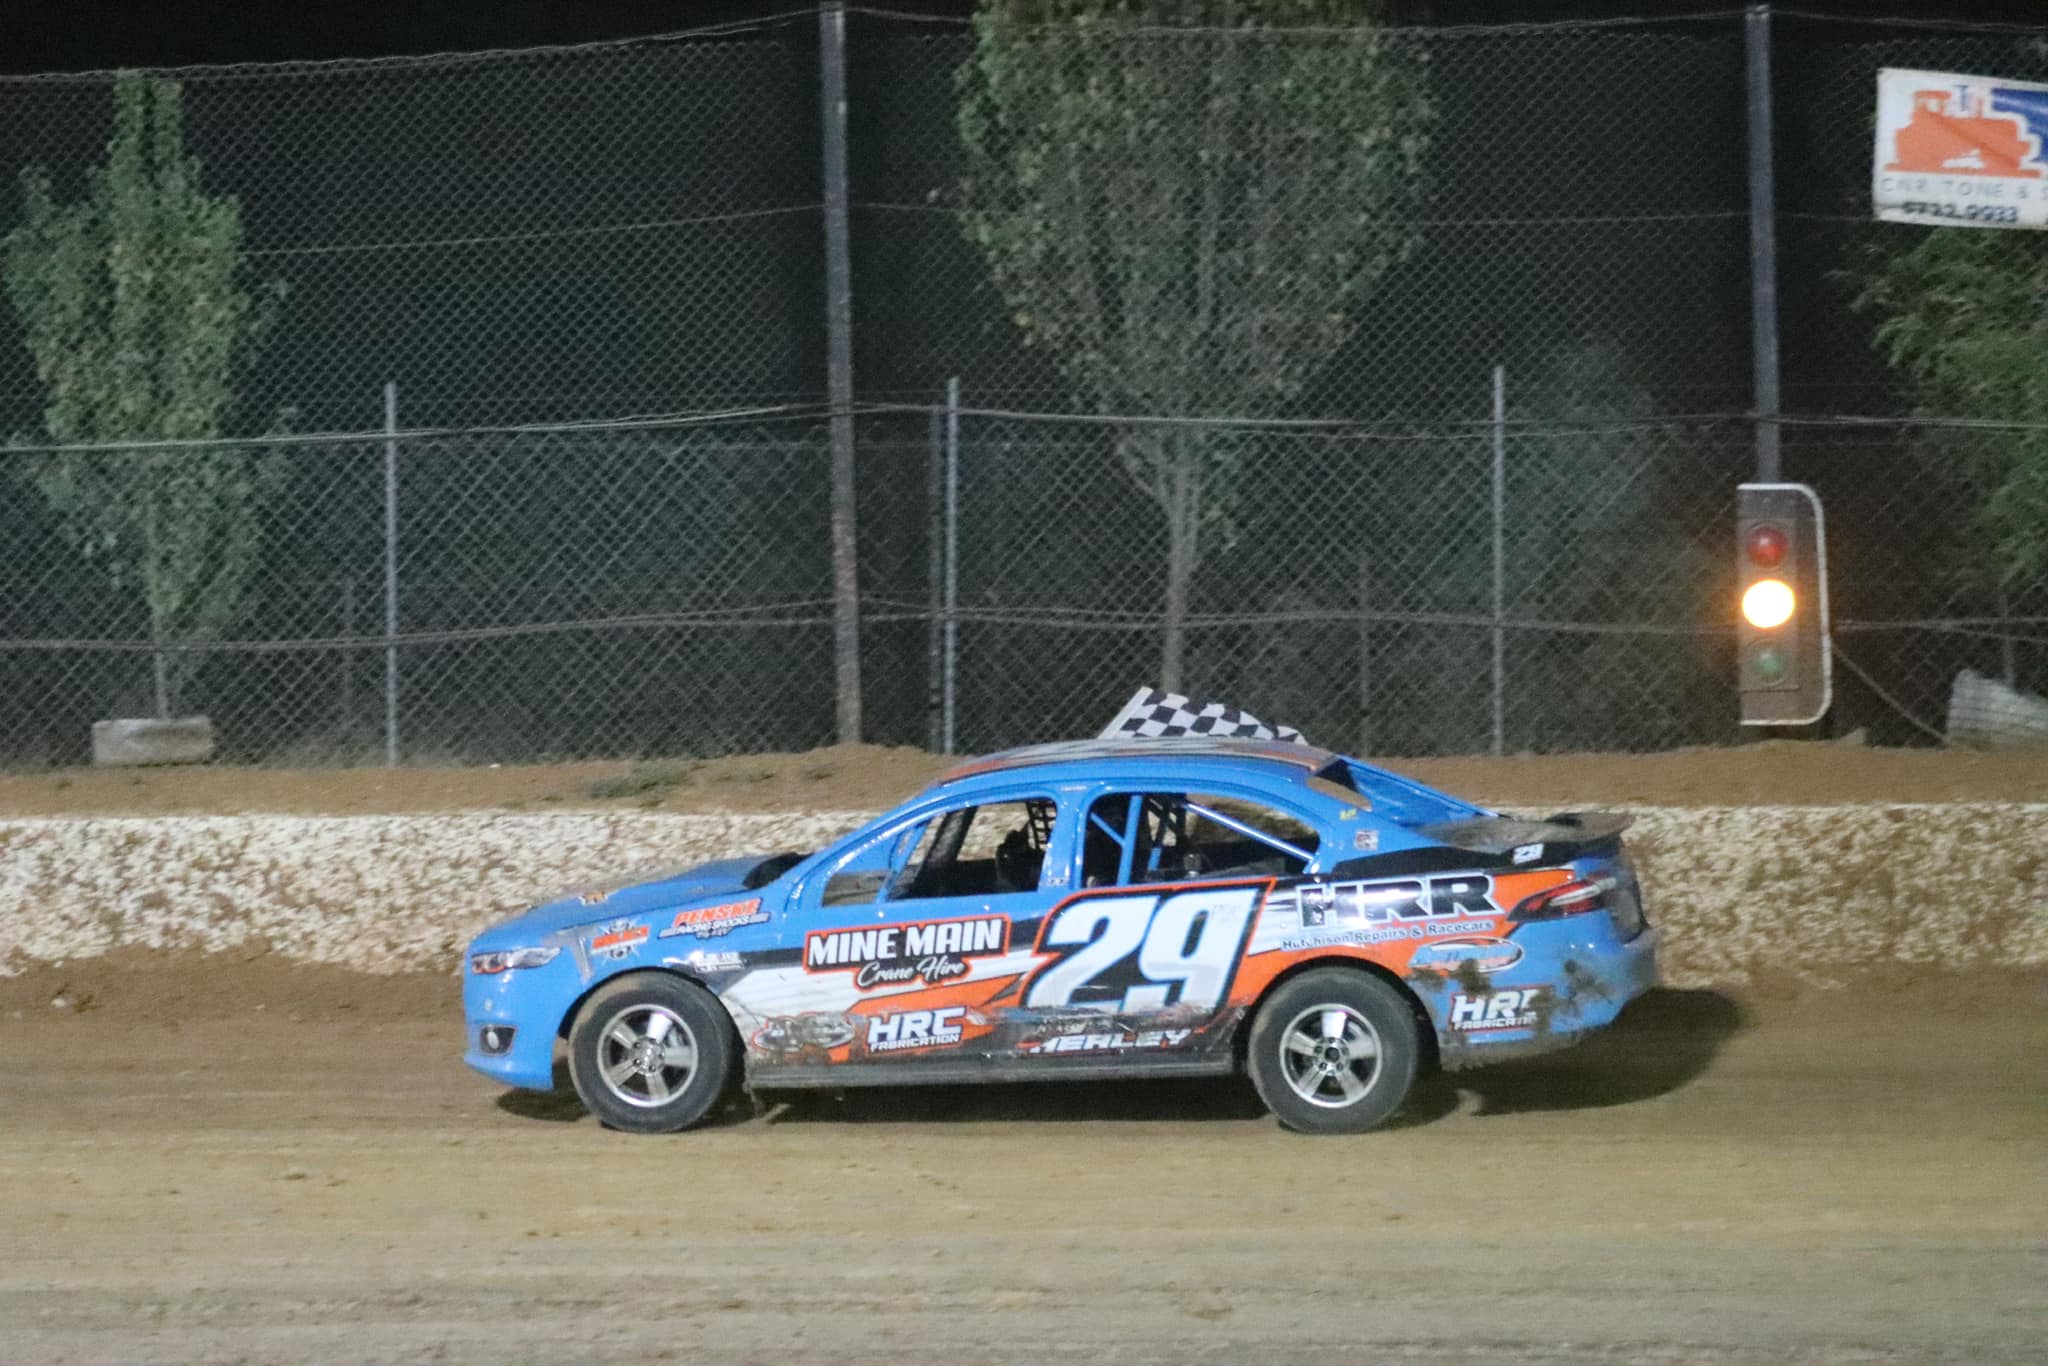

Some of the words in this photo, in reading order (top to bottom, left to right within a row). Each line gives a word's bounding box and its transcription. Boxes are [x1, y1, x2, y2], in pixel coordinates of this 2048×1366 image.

[673, 897, 762, 928] PENSKE
[1296, 872, 1505, 929] HRR
[808, 928, 900, 967] MINE
[905, 919, 1002, 957] MAIN
[1355, 928, 1406, 944] Repairs
[1411, 926, 1422, 937] &
[1428, 921, 1493, 935] Racecars
[1027, 887, 1261, 1014] 29
[857, 961, 914, 987] Crane
[916, 955, 966, 982] Hire
[868, 1006, 966, 1043] HRC
[870, 1033, 960, 1053] FABRICATION
